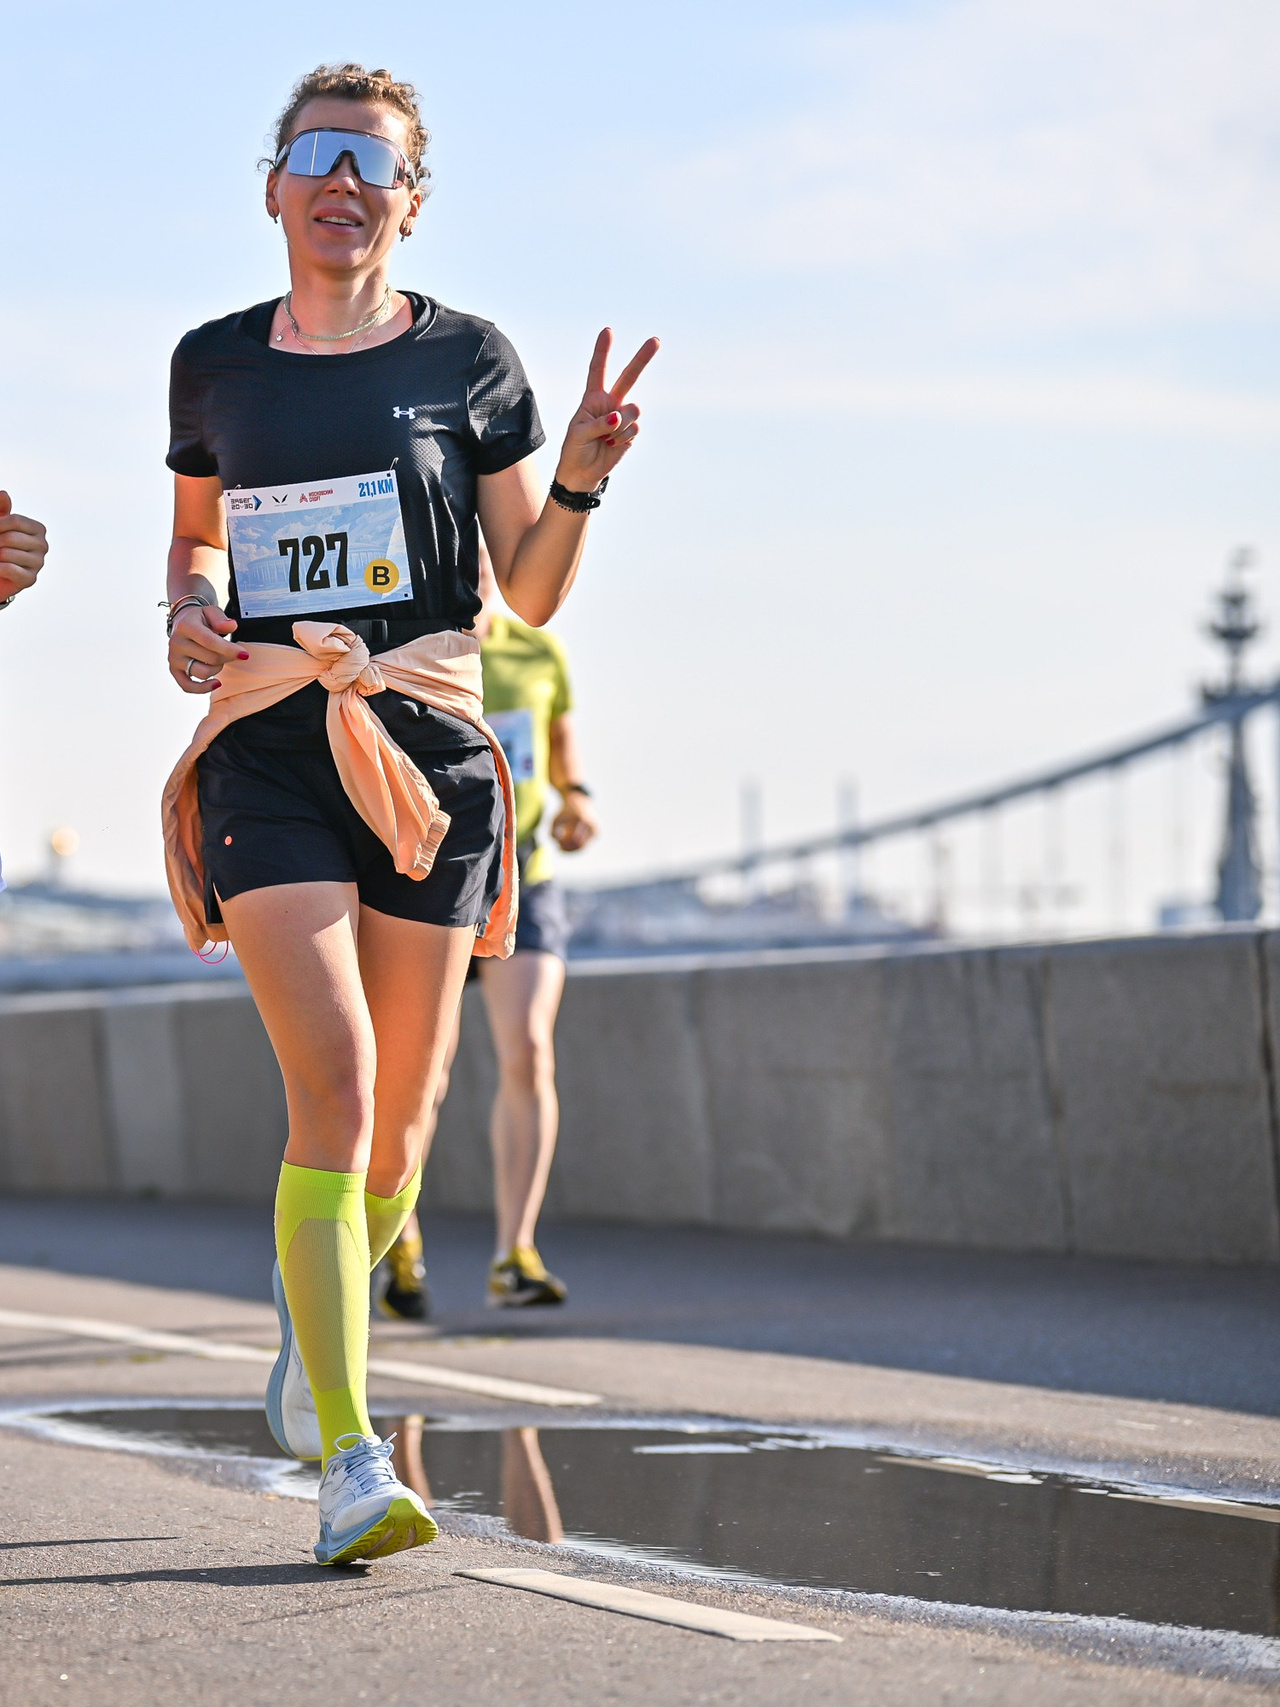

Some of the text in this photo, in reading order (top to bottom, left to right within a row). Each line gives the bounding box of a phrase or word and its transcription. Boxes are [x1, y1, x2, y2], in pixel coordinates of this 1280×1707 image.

[358, 480, 377, 498] 21,1
[278, 532, 349, 593] 727
[372, 566, 391, 586] B
